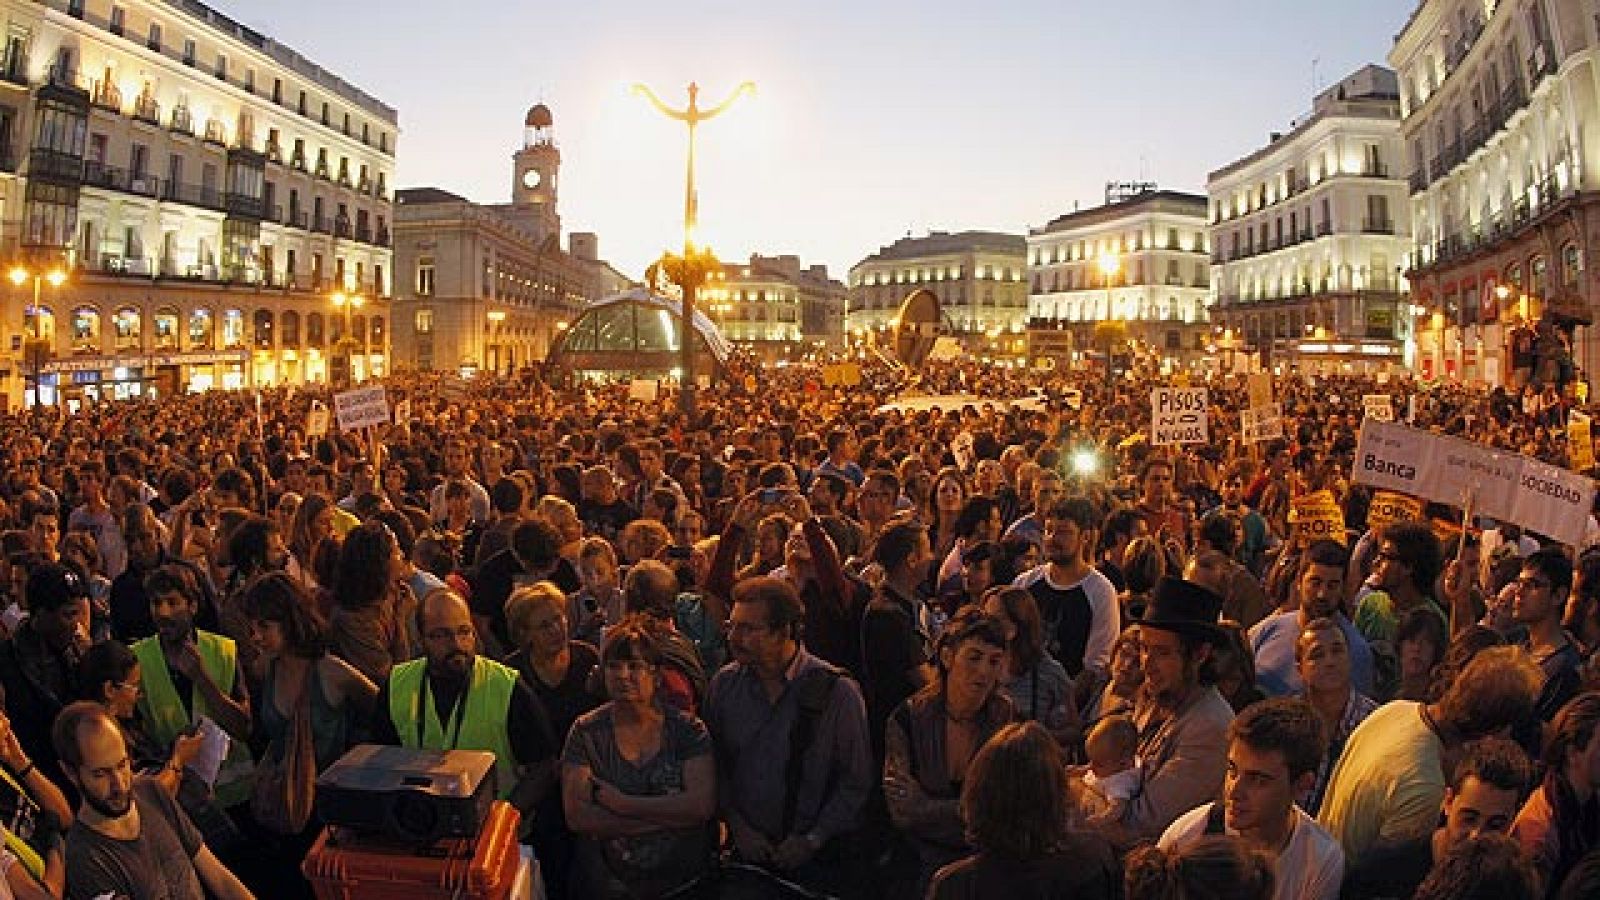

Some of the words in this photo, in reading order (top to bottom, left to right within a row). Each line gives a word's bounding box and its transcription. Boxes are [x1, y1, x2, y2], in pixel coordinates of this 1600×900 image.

[1160, 414, 1198, 426] NO
[1364, 454, 1416, 480] Banca
[1520, 474, 1582, 505] SOCIEDAD
